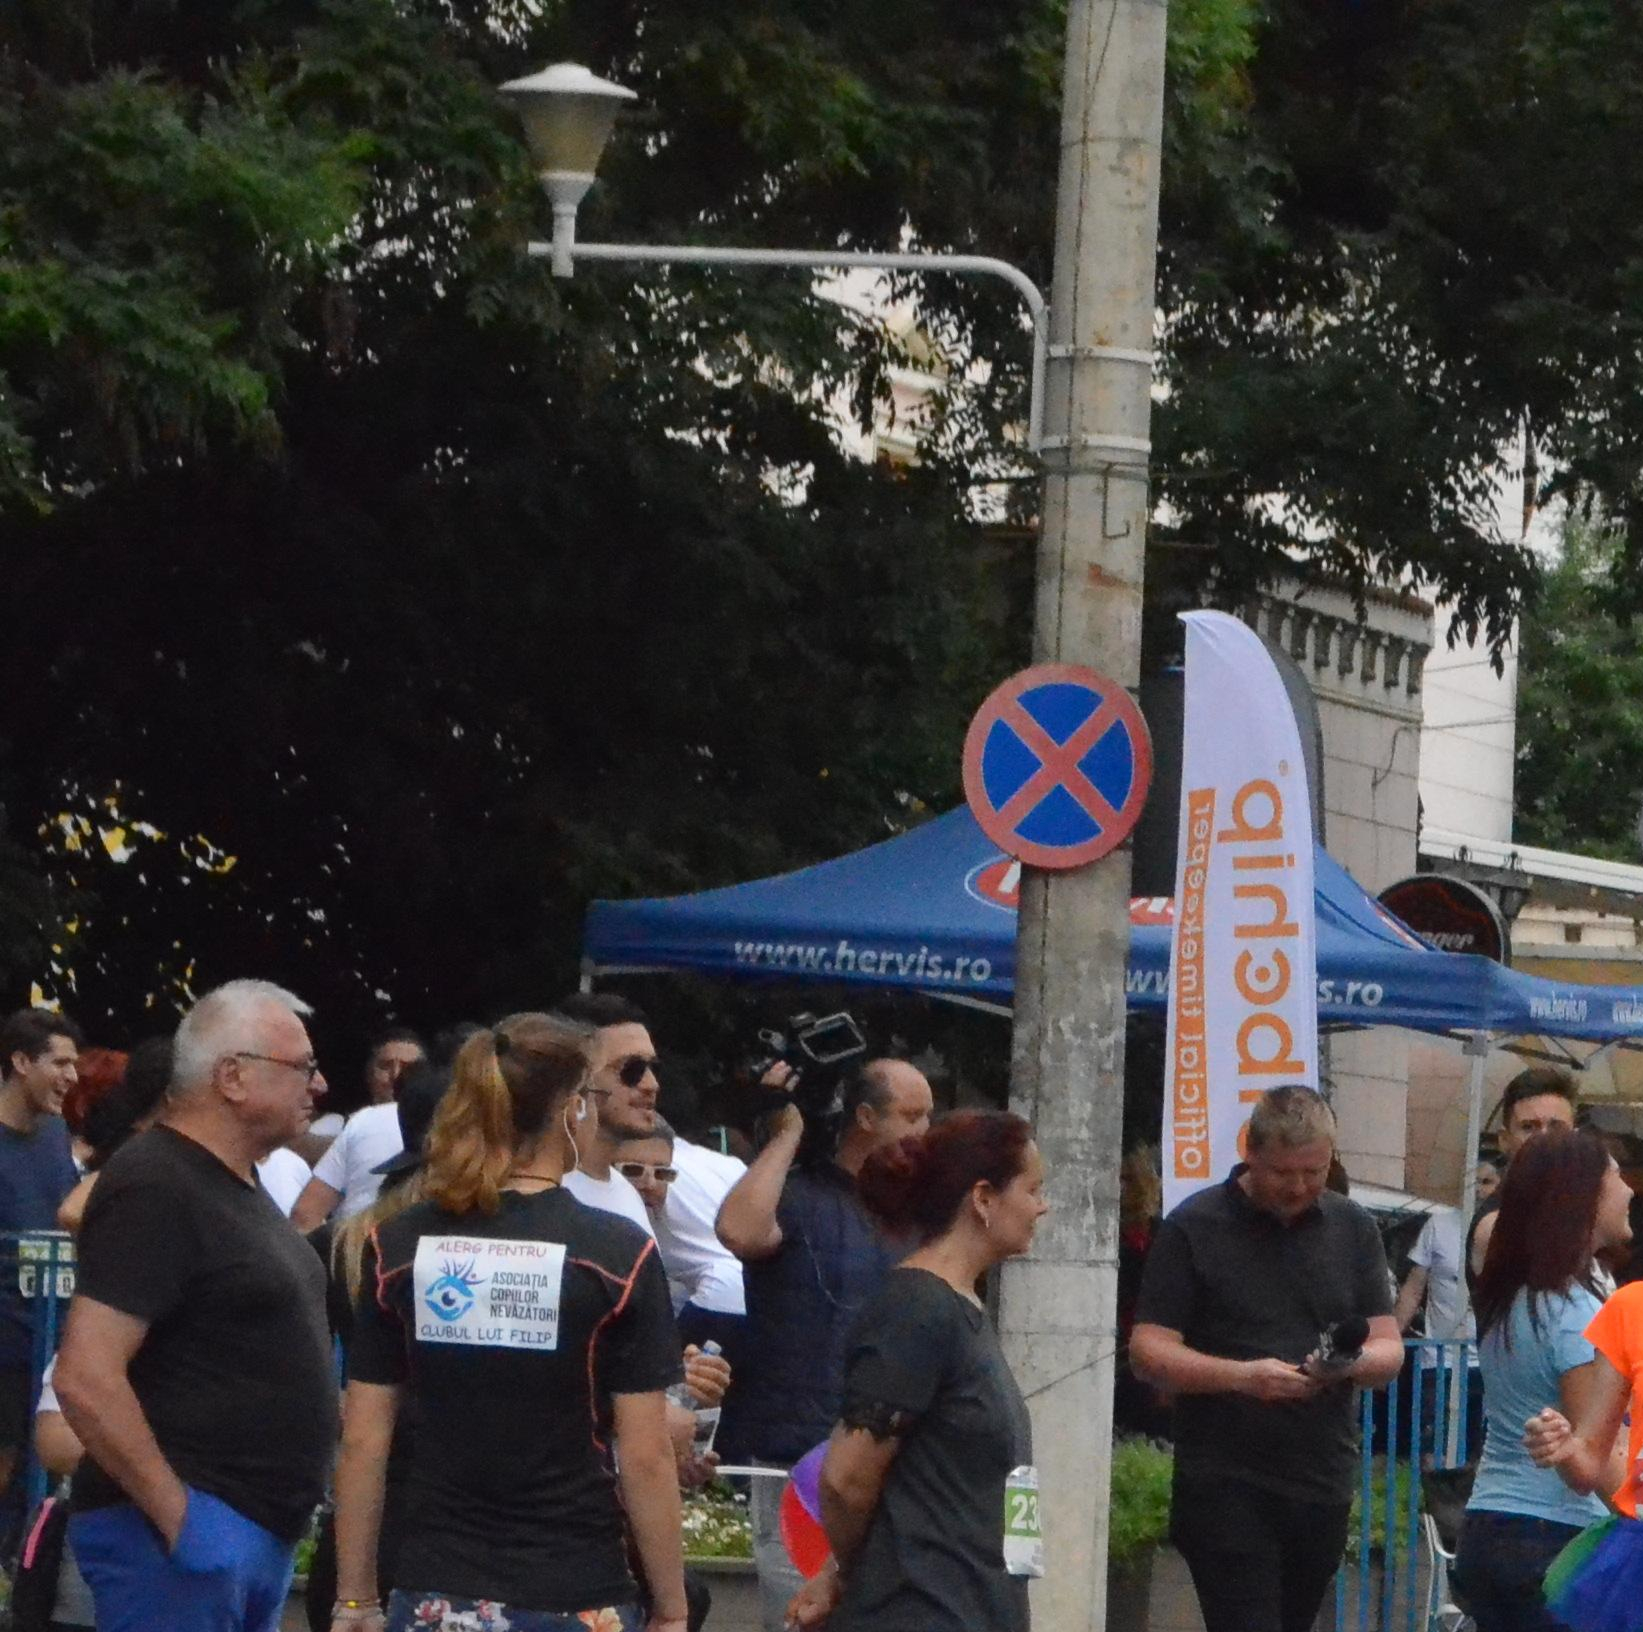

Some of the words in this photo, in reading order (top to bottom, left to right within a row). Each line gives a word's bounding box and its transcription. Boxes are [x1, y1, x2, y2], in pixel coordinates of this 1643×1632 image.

[734, 940, 993, 982] www.hervis.ro
[436, 1241, 482, 1255] ALERG
[488, 1244, 547, 1258] PENTRU
[490, 1288, 539, 1303] COPIILOR
[421, 1325, 471, 1340] CLUBUL
[478, 1328, 503, 1341] LUI
[510, 1329, 552, 1343] FILIP
[1011, 1493, 1041, 1532] 23
